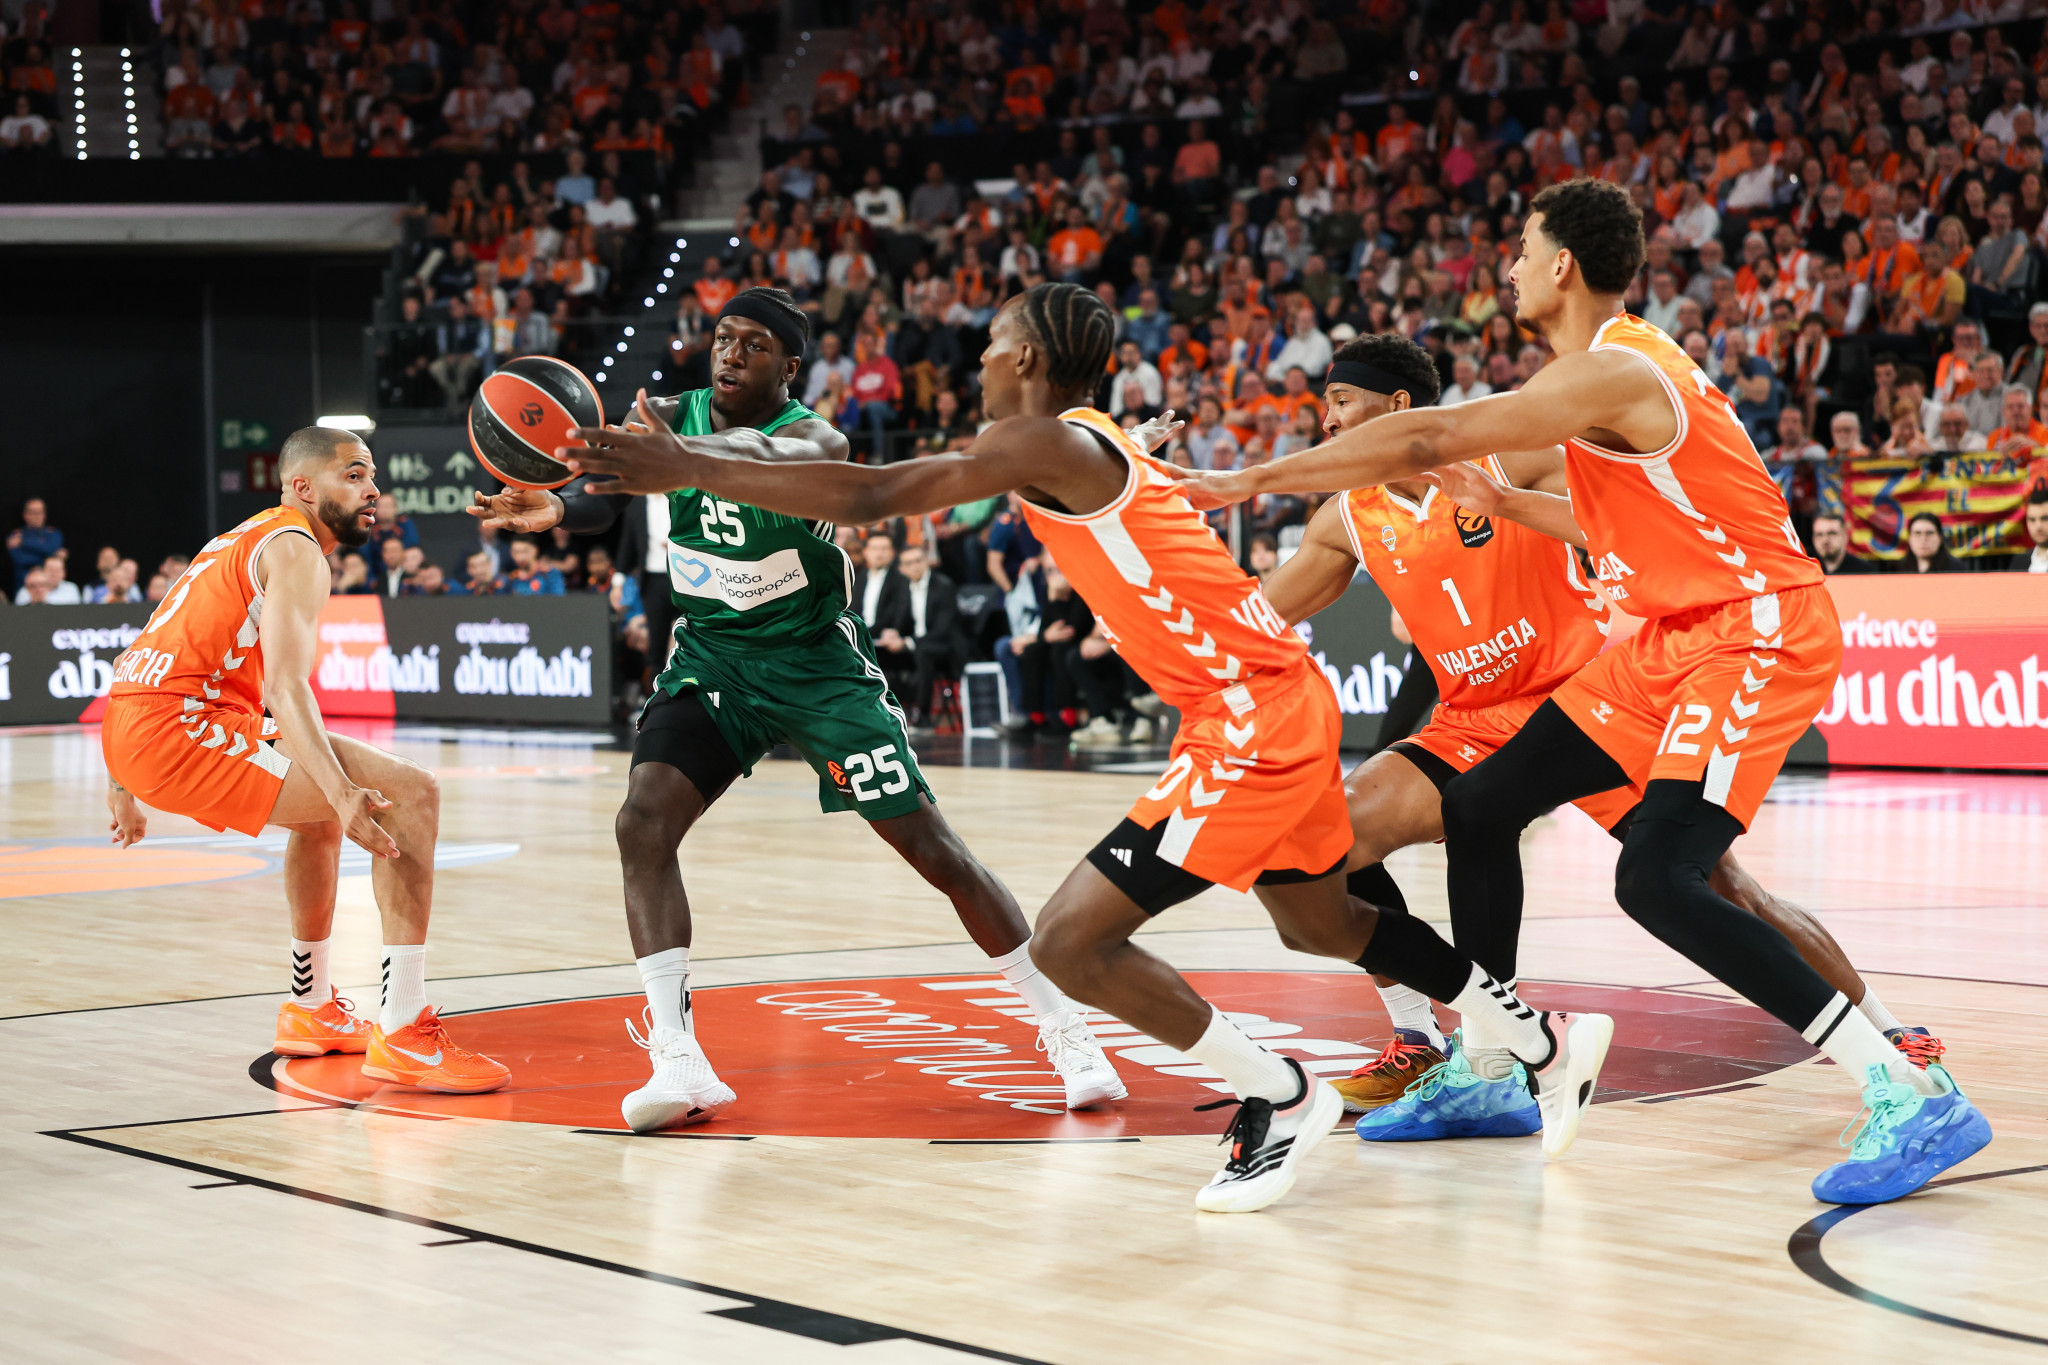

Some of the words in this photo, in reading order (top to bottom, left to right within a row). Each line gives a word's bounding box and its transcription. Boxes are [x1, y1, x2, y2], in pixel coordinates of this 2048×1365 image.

[391, 485, 476, 514] SALIDA
[700, 495, 746, 547] 25
[1947, 488, 1970, 512] EL
[716, 568, 763, 585] Ομάδα
[1441, 577, 1472, 627] 1
[318, 645, 367, 691] abu
[454, 647, 509, 695] abu
[1436, 617, 1538, 677] VALENCIA
[1468, 652, 1519, 686] BASKET
[1656, 703, 1712, 757] 12
[844, 744, 910, 802] 25
